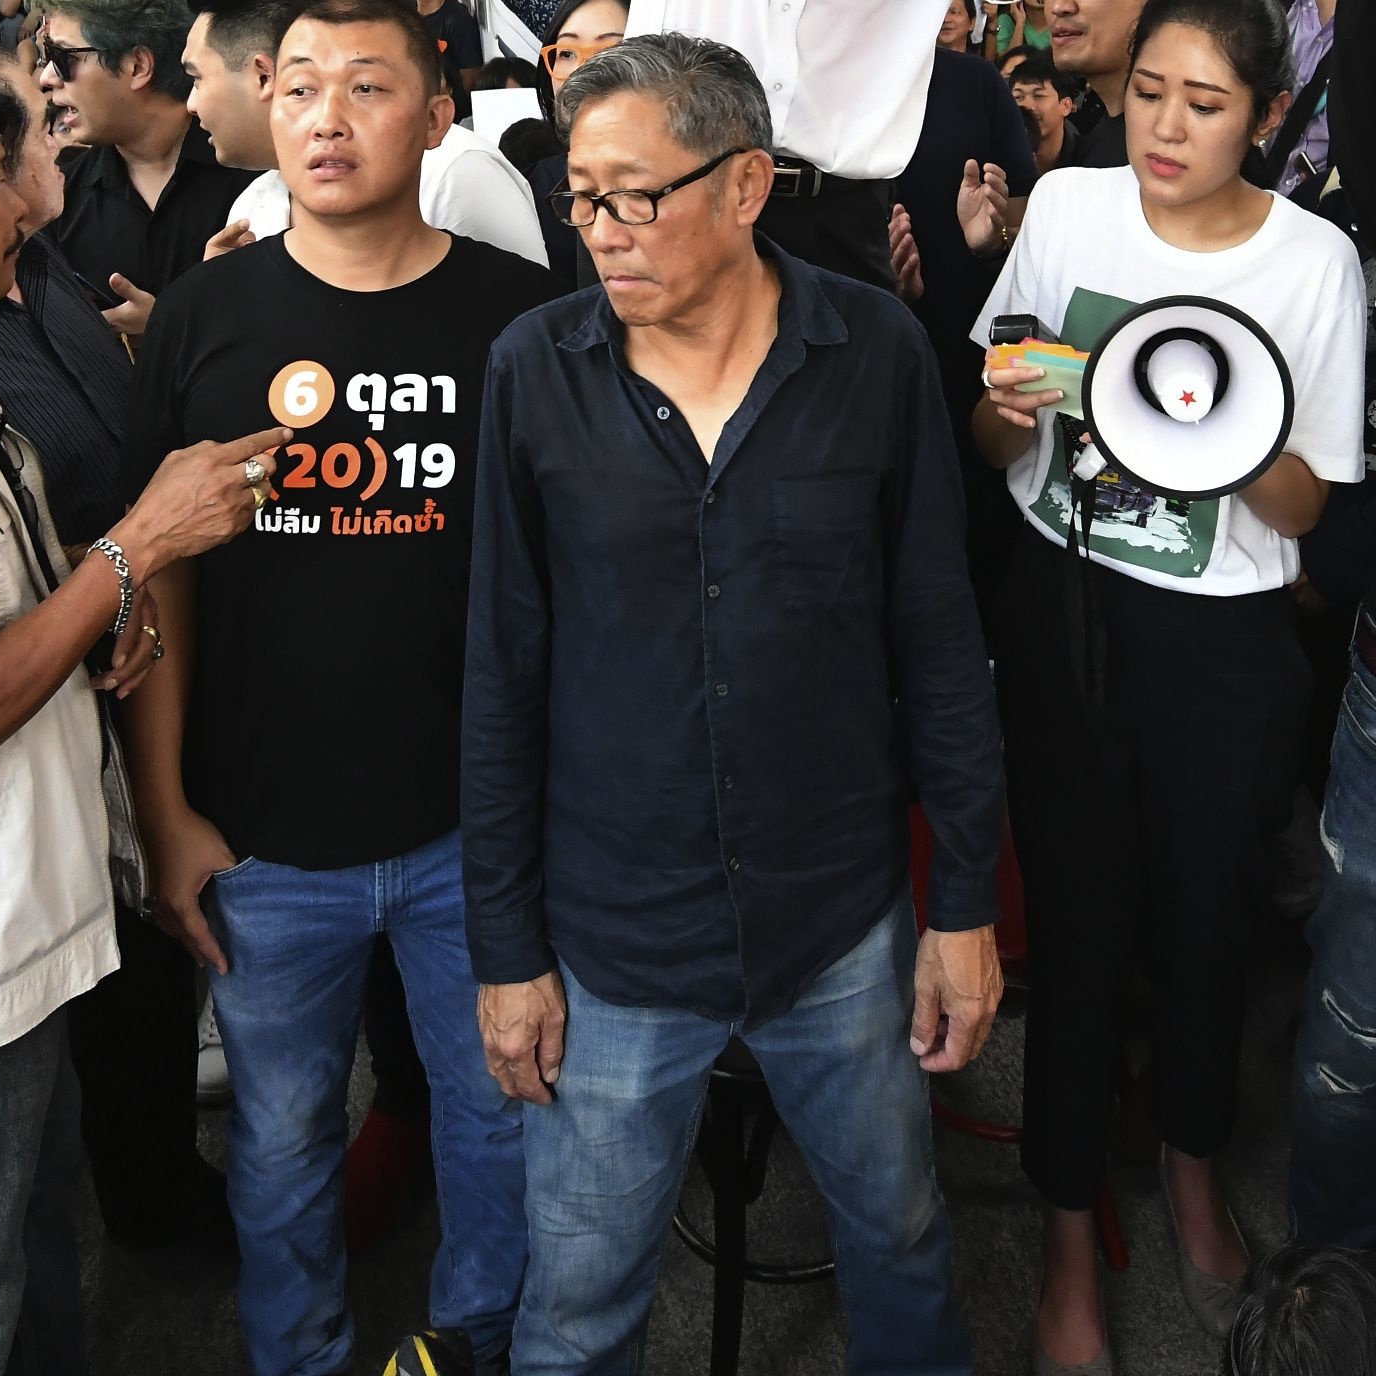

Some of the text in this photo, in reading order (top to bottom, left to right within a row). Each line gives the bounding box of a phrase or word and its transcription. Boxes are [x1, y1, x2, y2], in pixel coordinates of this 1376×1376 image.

[284, 370, 457, 431] 6 ตุลา
[330, 497, 445, 535] ไม่เกิดซ้ำ
